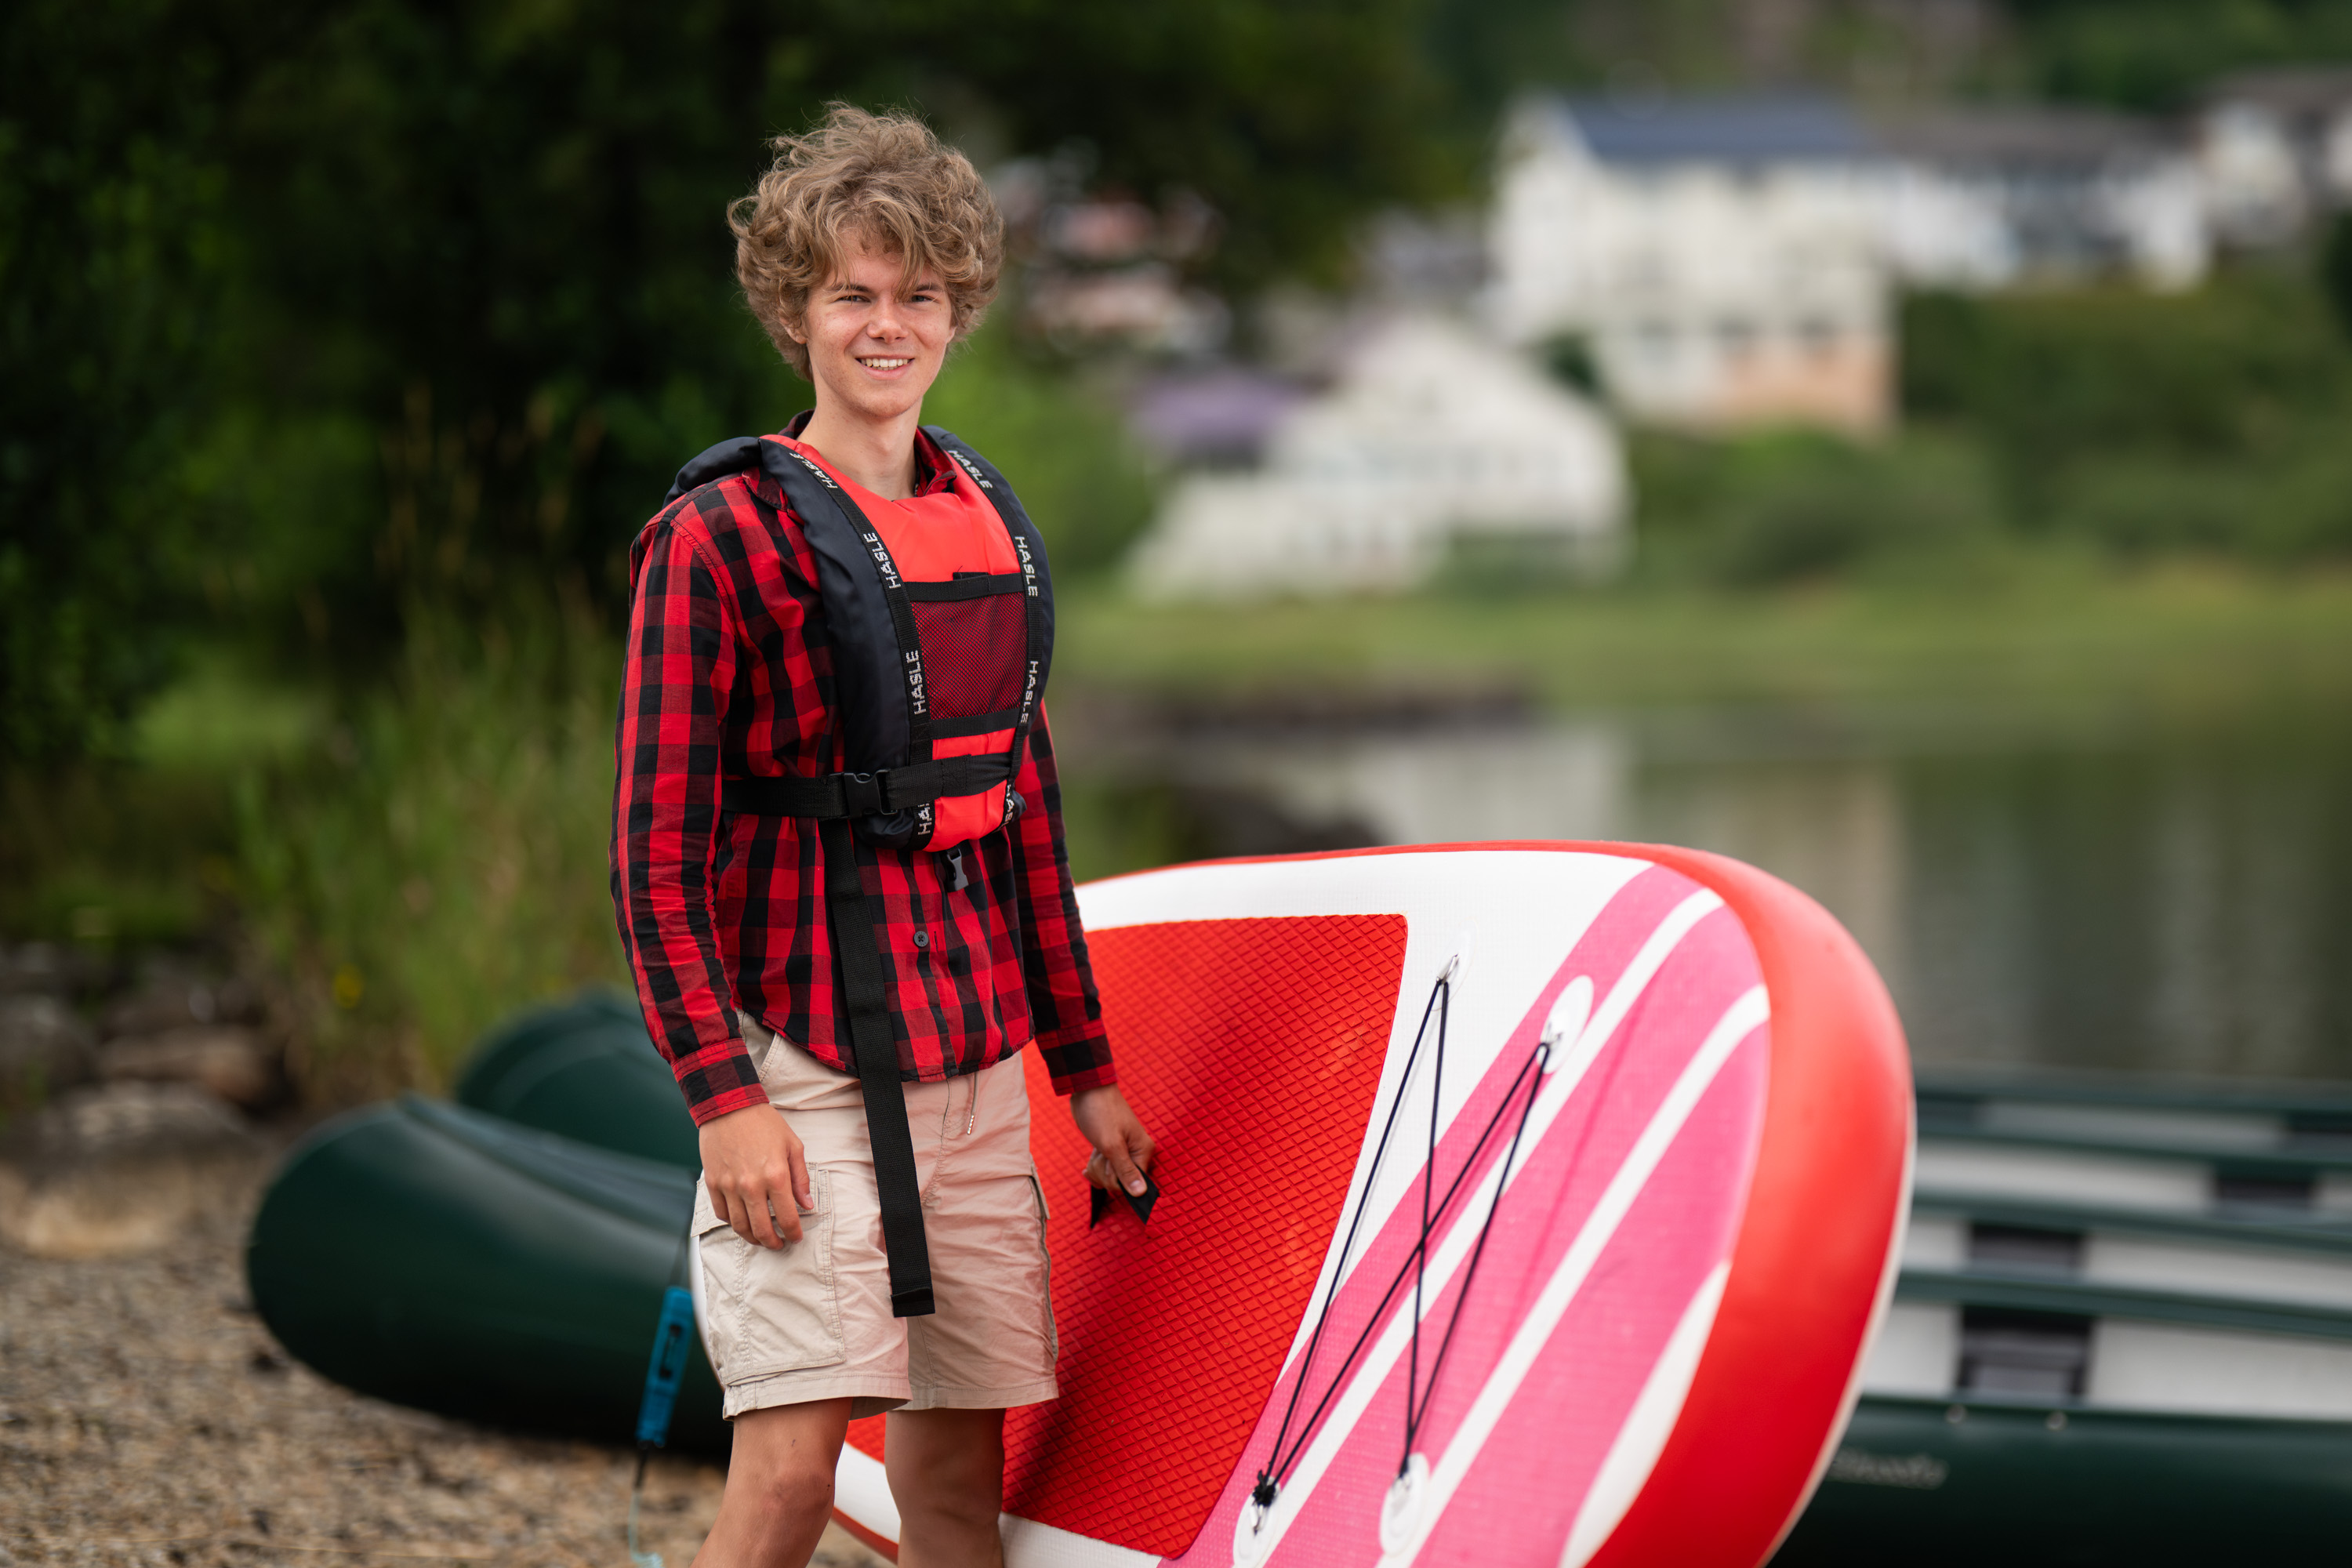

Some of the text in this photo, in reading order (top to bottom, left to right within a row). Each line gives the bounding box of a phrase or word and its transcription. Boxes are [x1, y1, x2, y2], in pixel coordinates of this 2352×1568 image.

[789, 452, 838, 488] HASLE
[948, 450, 993, 489] HASLE
[863, 532, 902, 589] HASLE
[1014, 535, 1039, 597] HASLE
[906, 650, 927, 715] HASLE
[1021, 660, 1039, 723] HASLE
[917, 803, 932, 836] HA
